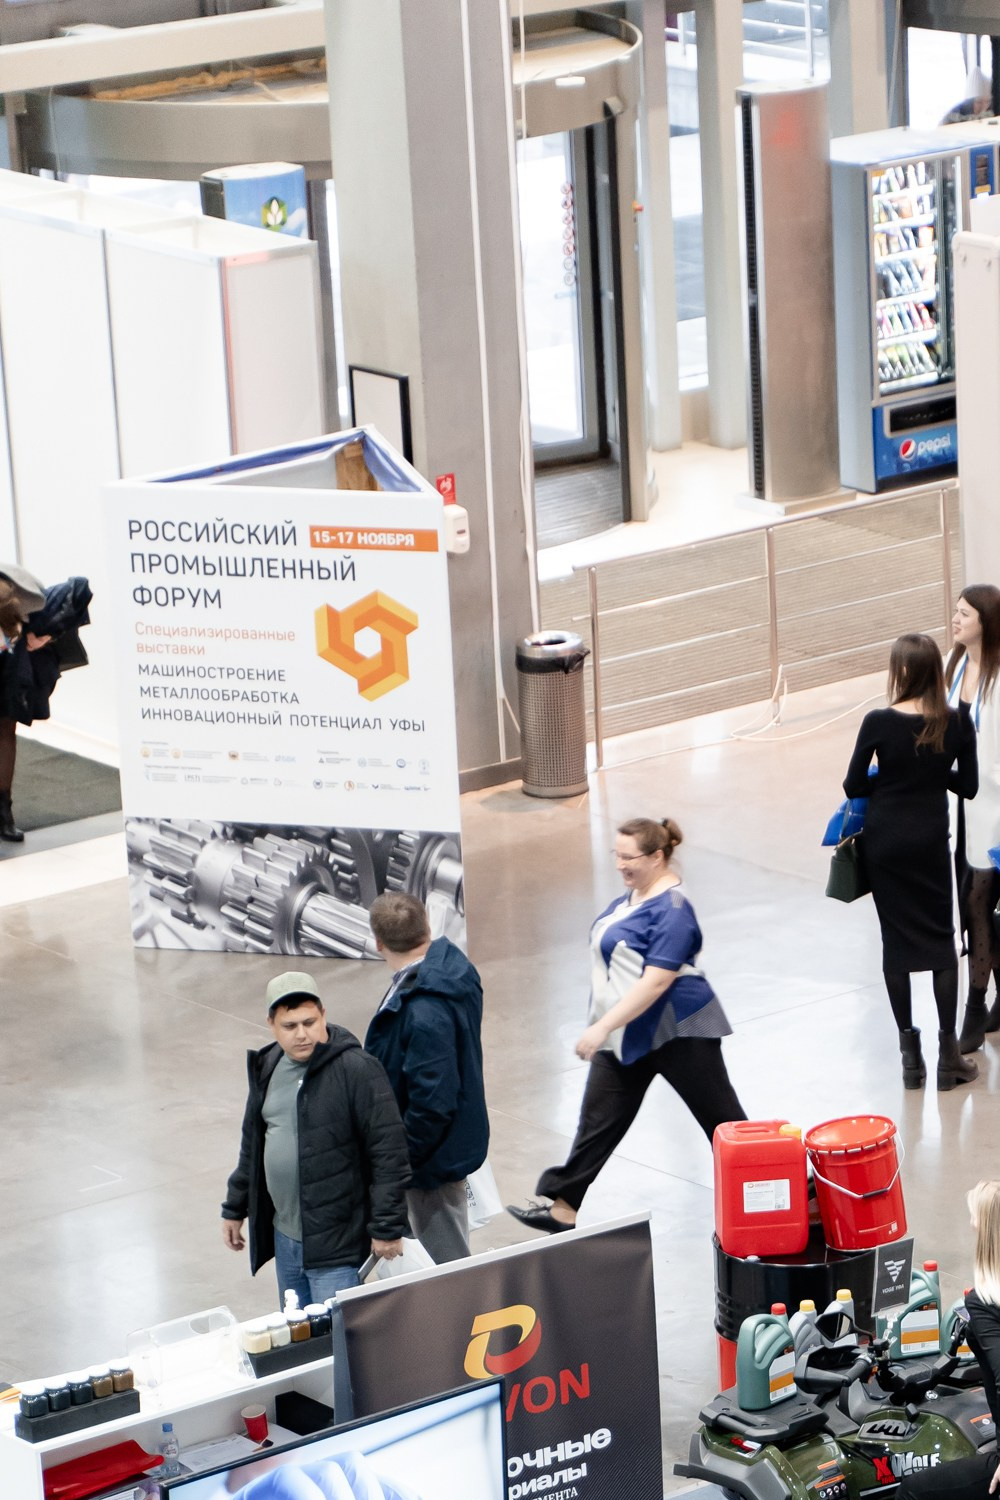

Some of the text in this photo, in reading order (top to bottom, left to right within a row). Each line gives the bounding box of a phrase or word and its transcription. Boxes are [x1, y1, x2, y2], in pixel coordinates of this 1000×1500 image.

[917, 432, 951, 456] pepsi
[128, 517, 298, 546] РОССИЙСКИЙ
[312, 530, 415, 547] 15-17 НОЯБРЯ
[130, 552, 357, 581] ПРОМЫШЛЕННЫЙ
[132, 585, 222, 609] ФОРУМ
[135, 622, 296, 642] Специализированные
[136, 643, 205, 655] выставки
[138, 664, 286, 682] МАШИНОСТРОЕНИЕ
[139, 685, 300, 705] МЕТАЛЛООБРАБОТКА
[141, 707, 426, 732] ИННОВАЦИОННЫЙ ПОТЕНЦИАЛ УФЫ
